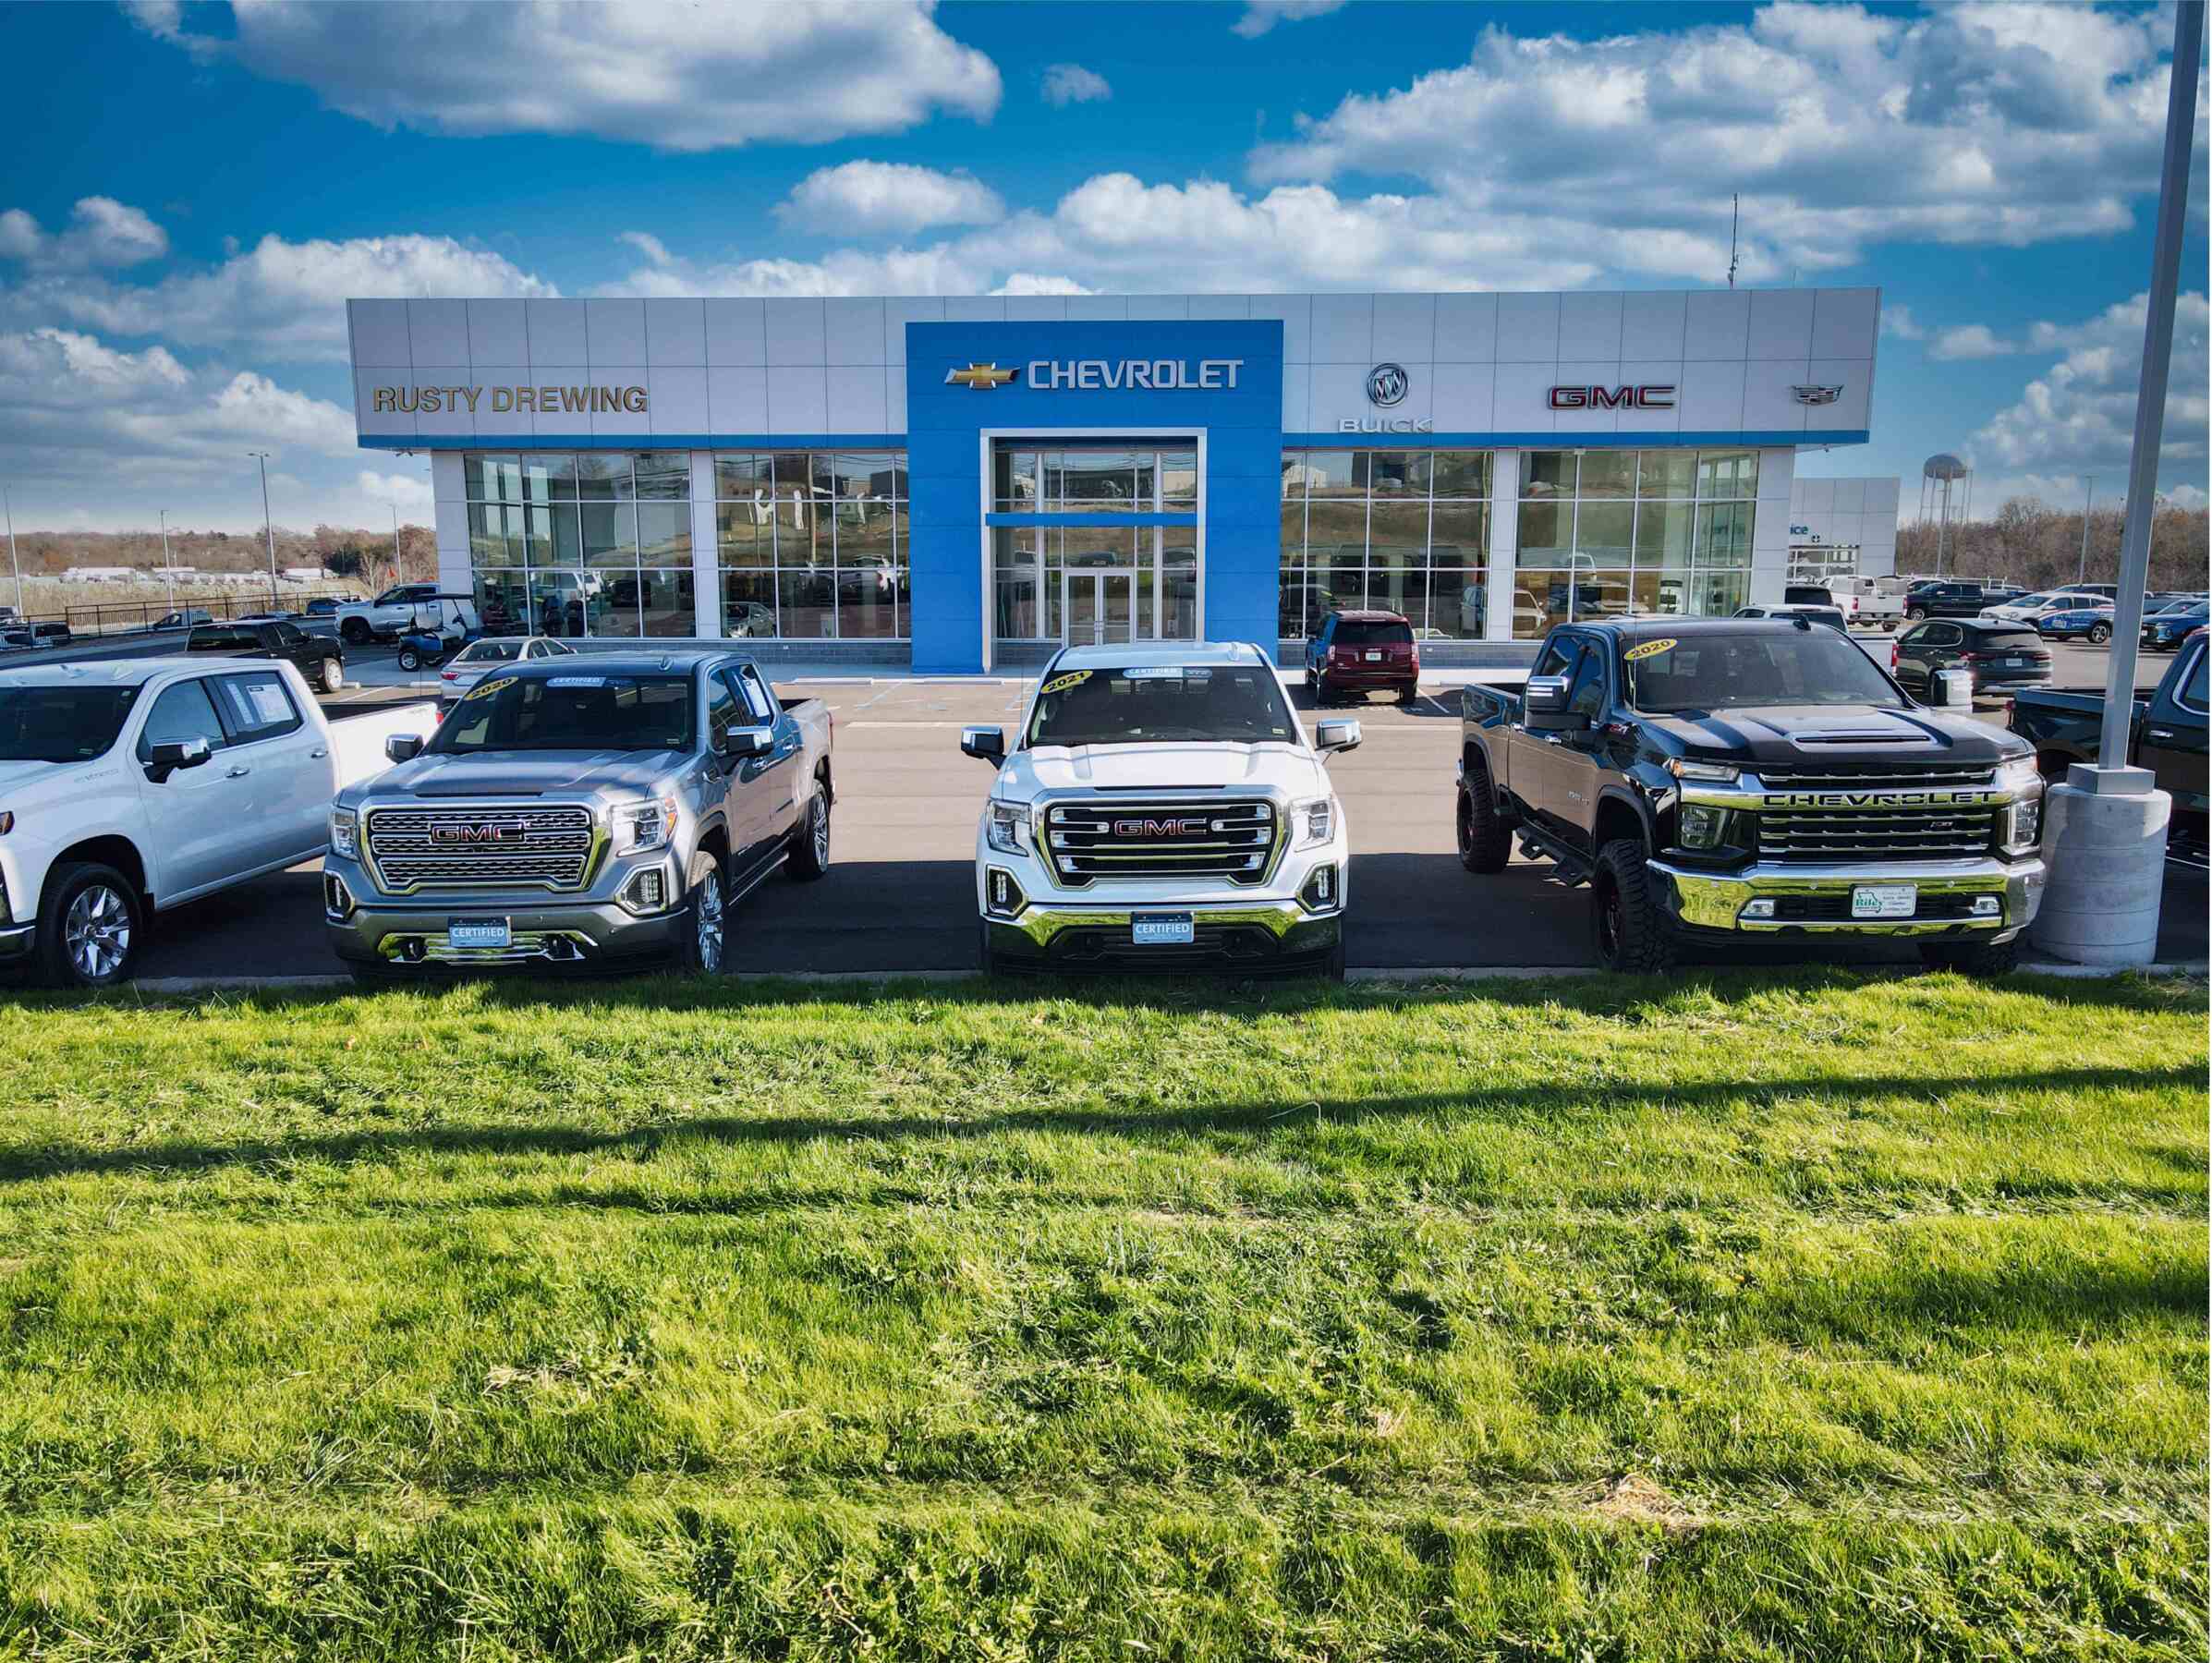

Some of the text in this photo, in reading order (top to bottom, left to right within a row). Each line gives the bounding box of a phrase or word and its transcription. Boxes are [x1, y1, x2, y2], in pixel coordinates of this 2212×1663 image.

[1028, 359, 1244, 390] CHEVROLET
[372, 386, 649, 413] RUSTY DREWING
[1547, 385, 1676, 409] GMC
[1338, 419, 1434, 433] BUICK
[1632, 640, 1671, 659] 2020
[472, 679, 513, 699] 2020
[1049, 672, 1084, 691] 2021
[1763, 792, 1998, 807] CHEVROLET
[431, 823, 524, 842] GMC
[1114, 818, 1207, 836] GMC
[452, 928, 504, 938] CERTIFIED
[1136, 924, 1190, 933] CERTIFIED
